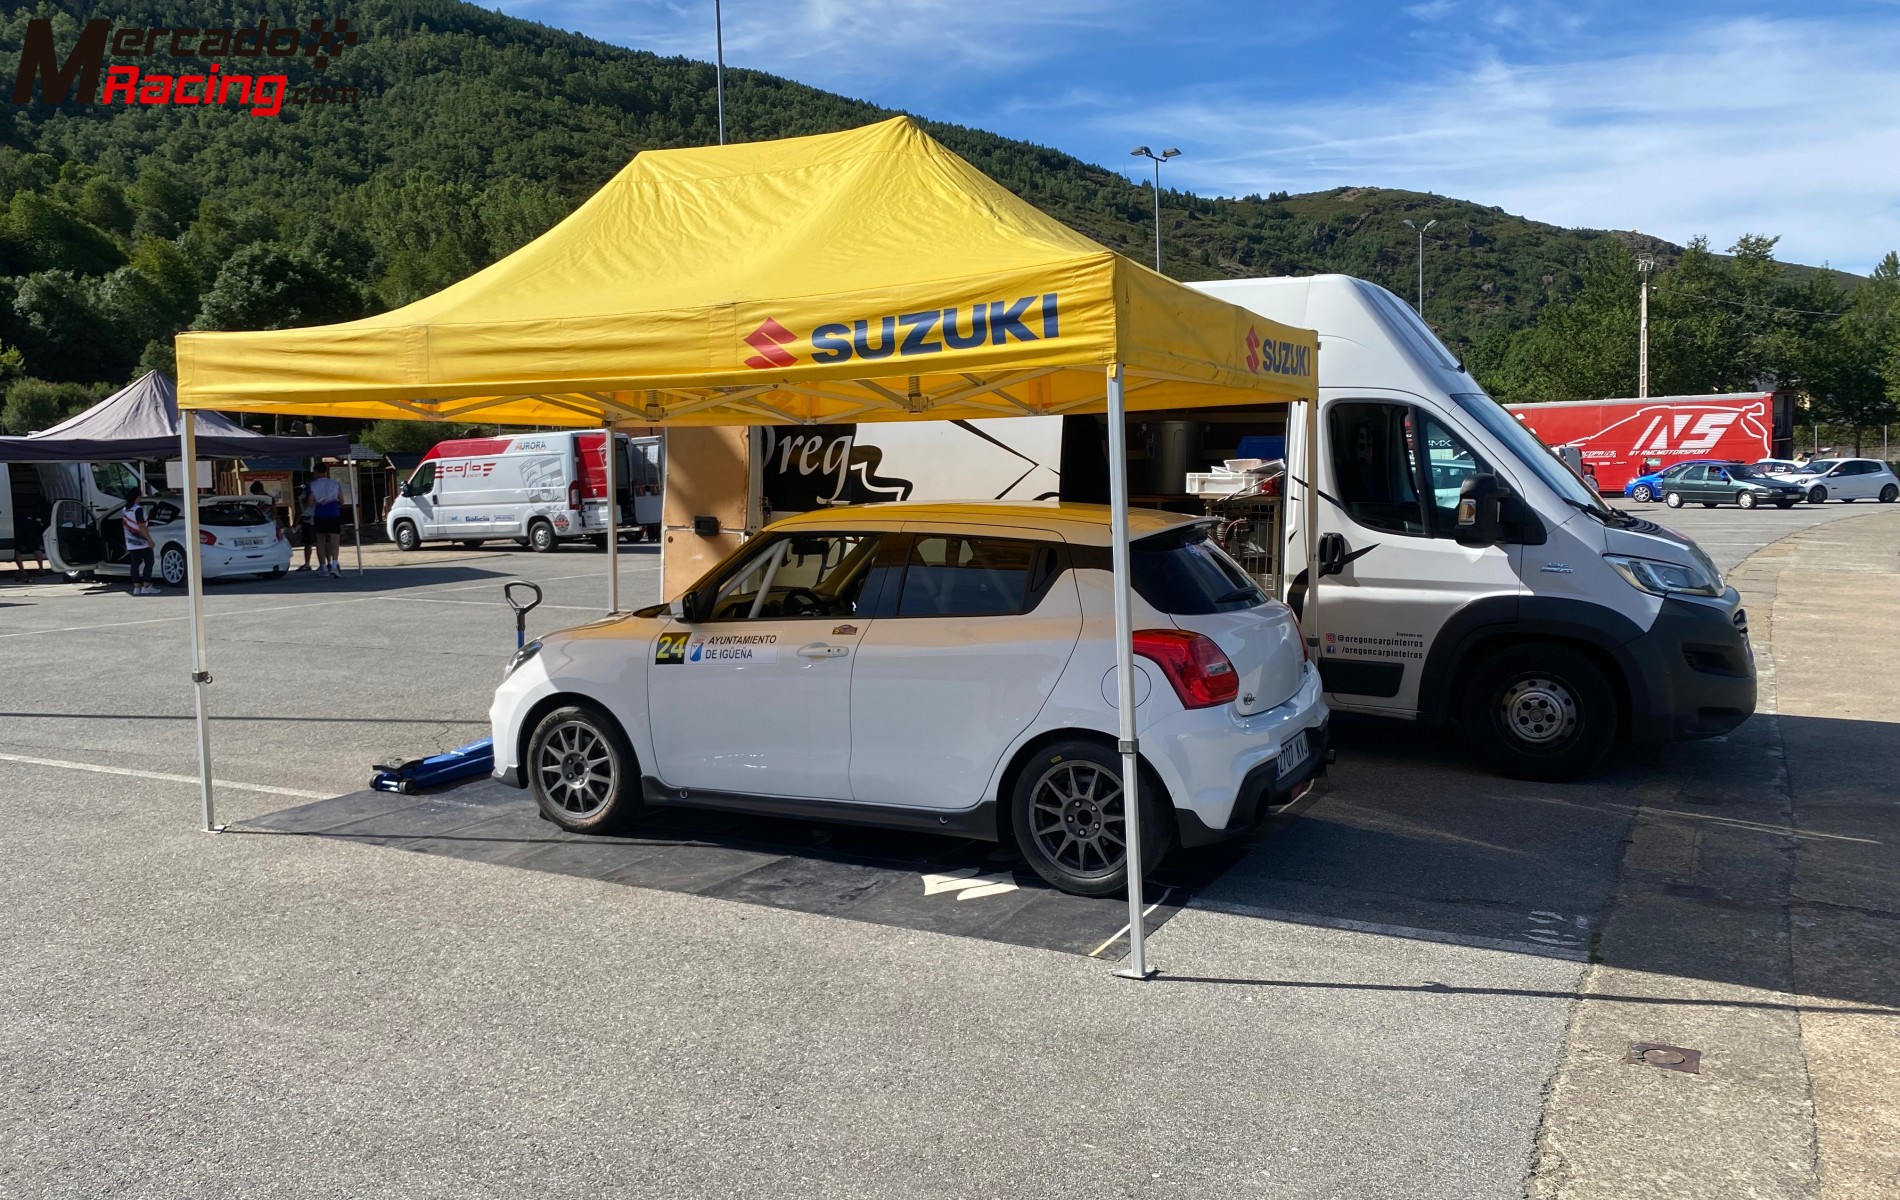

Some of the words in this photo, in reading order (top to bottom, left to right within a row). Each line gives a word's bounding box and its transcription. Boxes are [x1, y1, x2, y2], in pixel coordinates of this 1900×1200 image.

[811, 292, 1060, 364] SUZUKI
[1262, 338, 1311, 377] SUZUKI
[514, 441, 547, 451] AURORA
[465, 515, 490, 524] Galicia
[708, 635, 778, 645] AYUNTAMIENTO
[1337, 634, 1424, 648] @oregoncarpinteiros
[656, 636, 686, 659] 24
[705, 649, 719, 659] DE
[719, 647, 753, 659] IGÜEÑA
[1341, 646, 1423, 659] /oregoncarpinteiros
